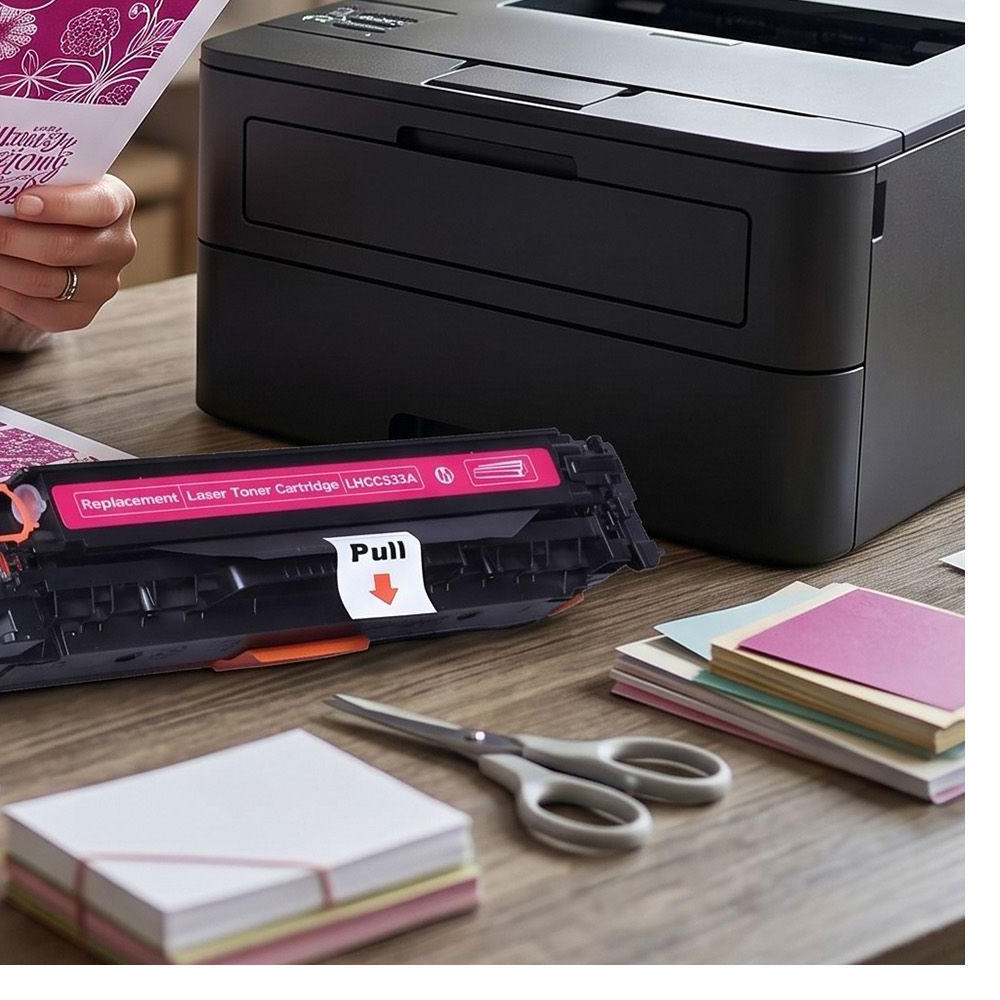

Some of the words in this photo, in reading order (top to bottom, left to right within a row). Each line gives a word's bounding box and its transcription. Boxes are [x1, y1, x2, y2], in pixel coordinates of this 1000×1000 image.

[81, 492, 179, 511] Replacement
[186, 488, 227, 502] Laser
[230, 486, 271, 498] Toner
[274, 480, 340, 494] Cartridge
[350, 541, 406, 562] Pull
